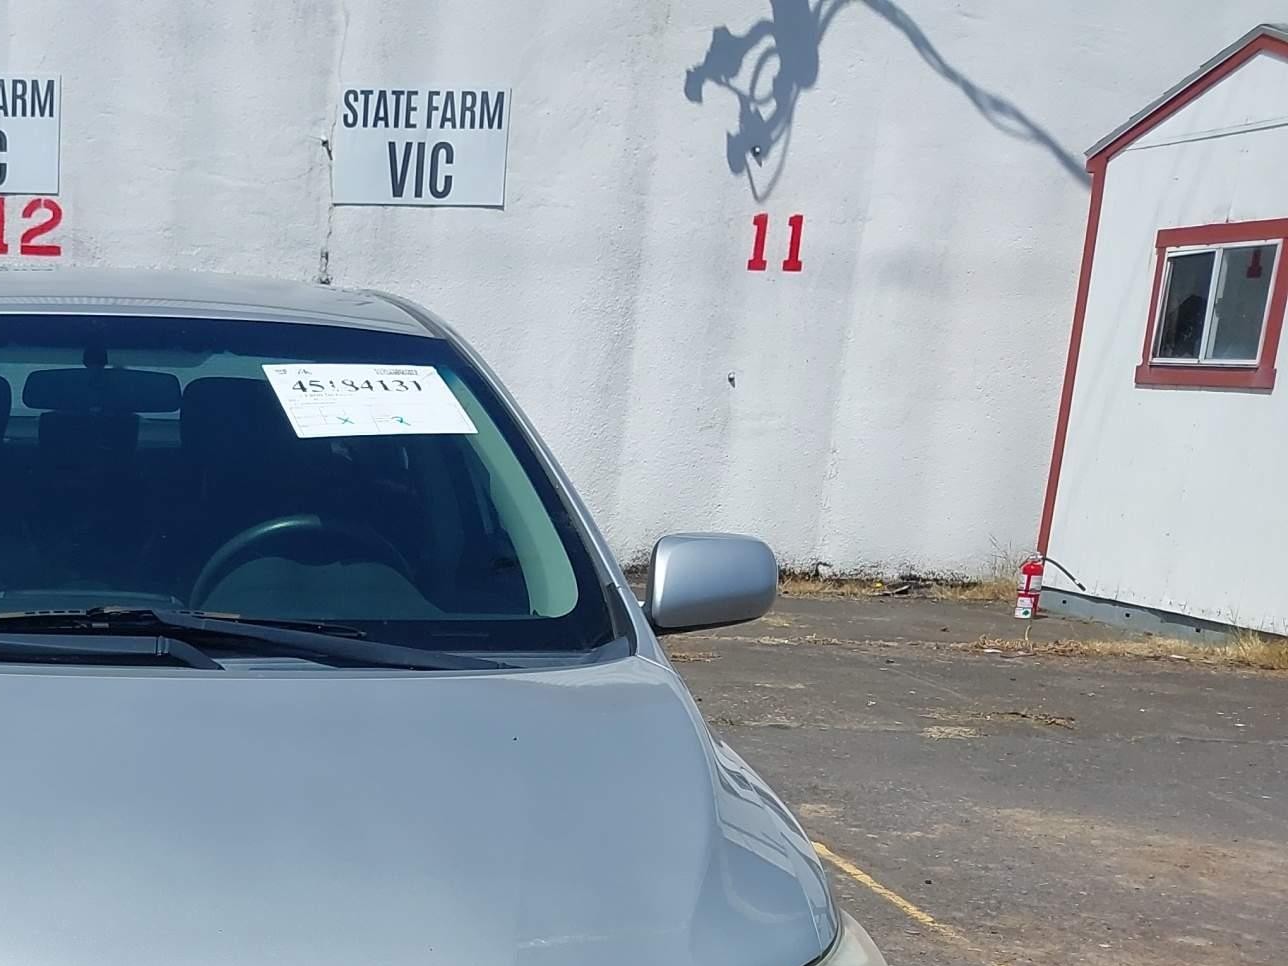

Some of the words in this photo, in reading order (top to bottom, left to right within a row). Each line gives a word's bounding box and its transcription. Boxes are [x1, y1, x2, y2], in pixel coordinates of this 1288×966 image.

[342, 89, 419, 129] STATE
[426, 90, 505, 130] FARM
[387, 141, 454, 199] VIC
[746, 212, 805, 273] 11
